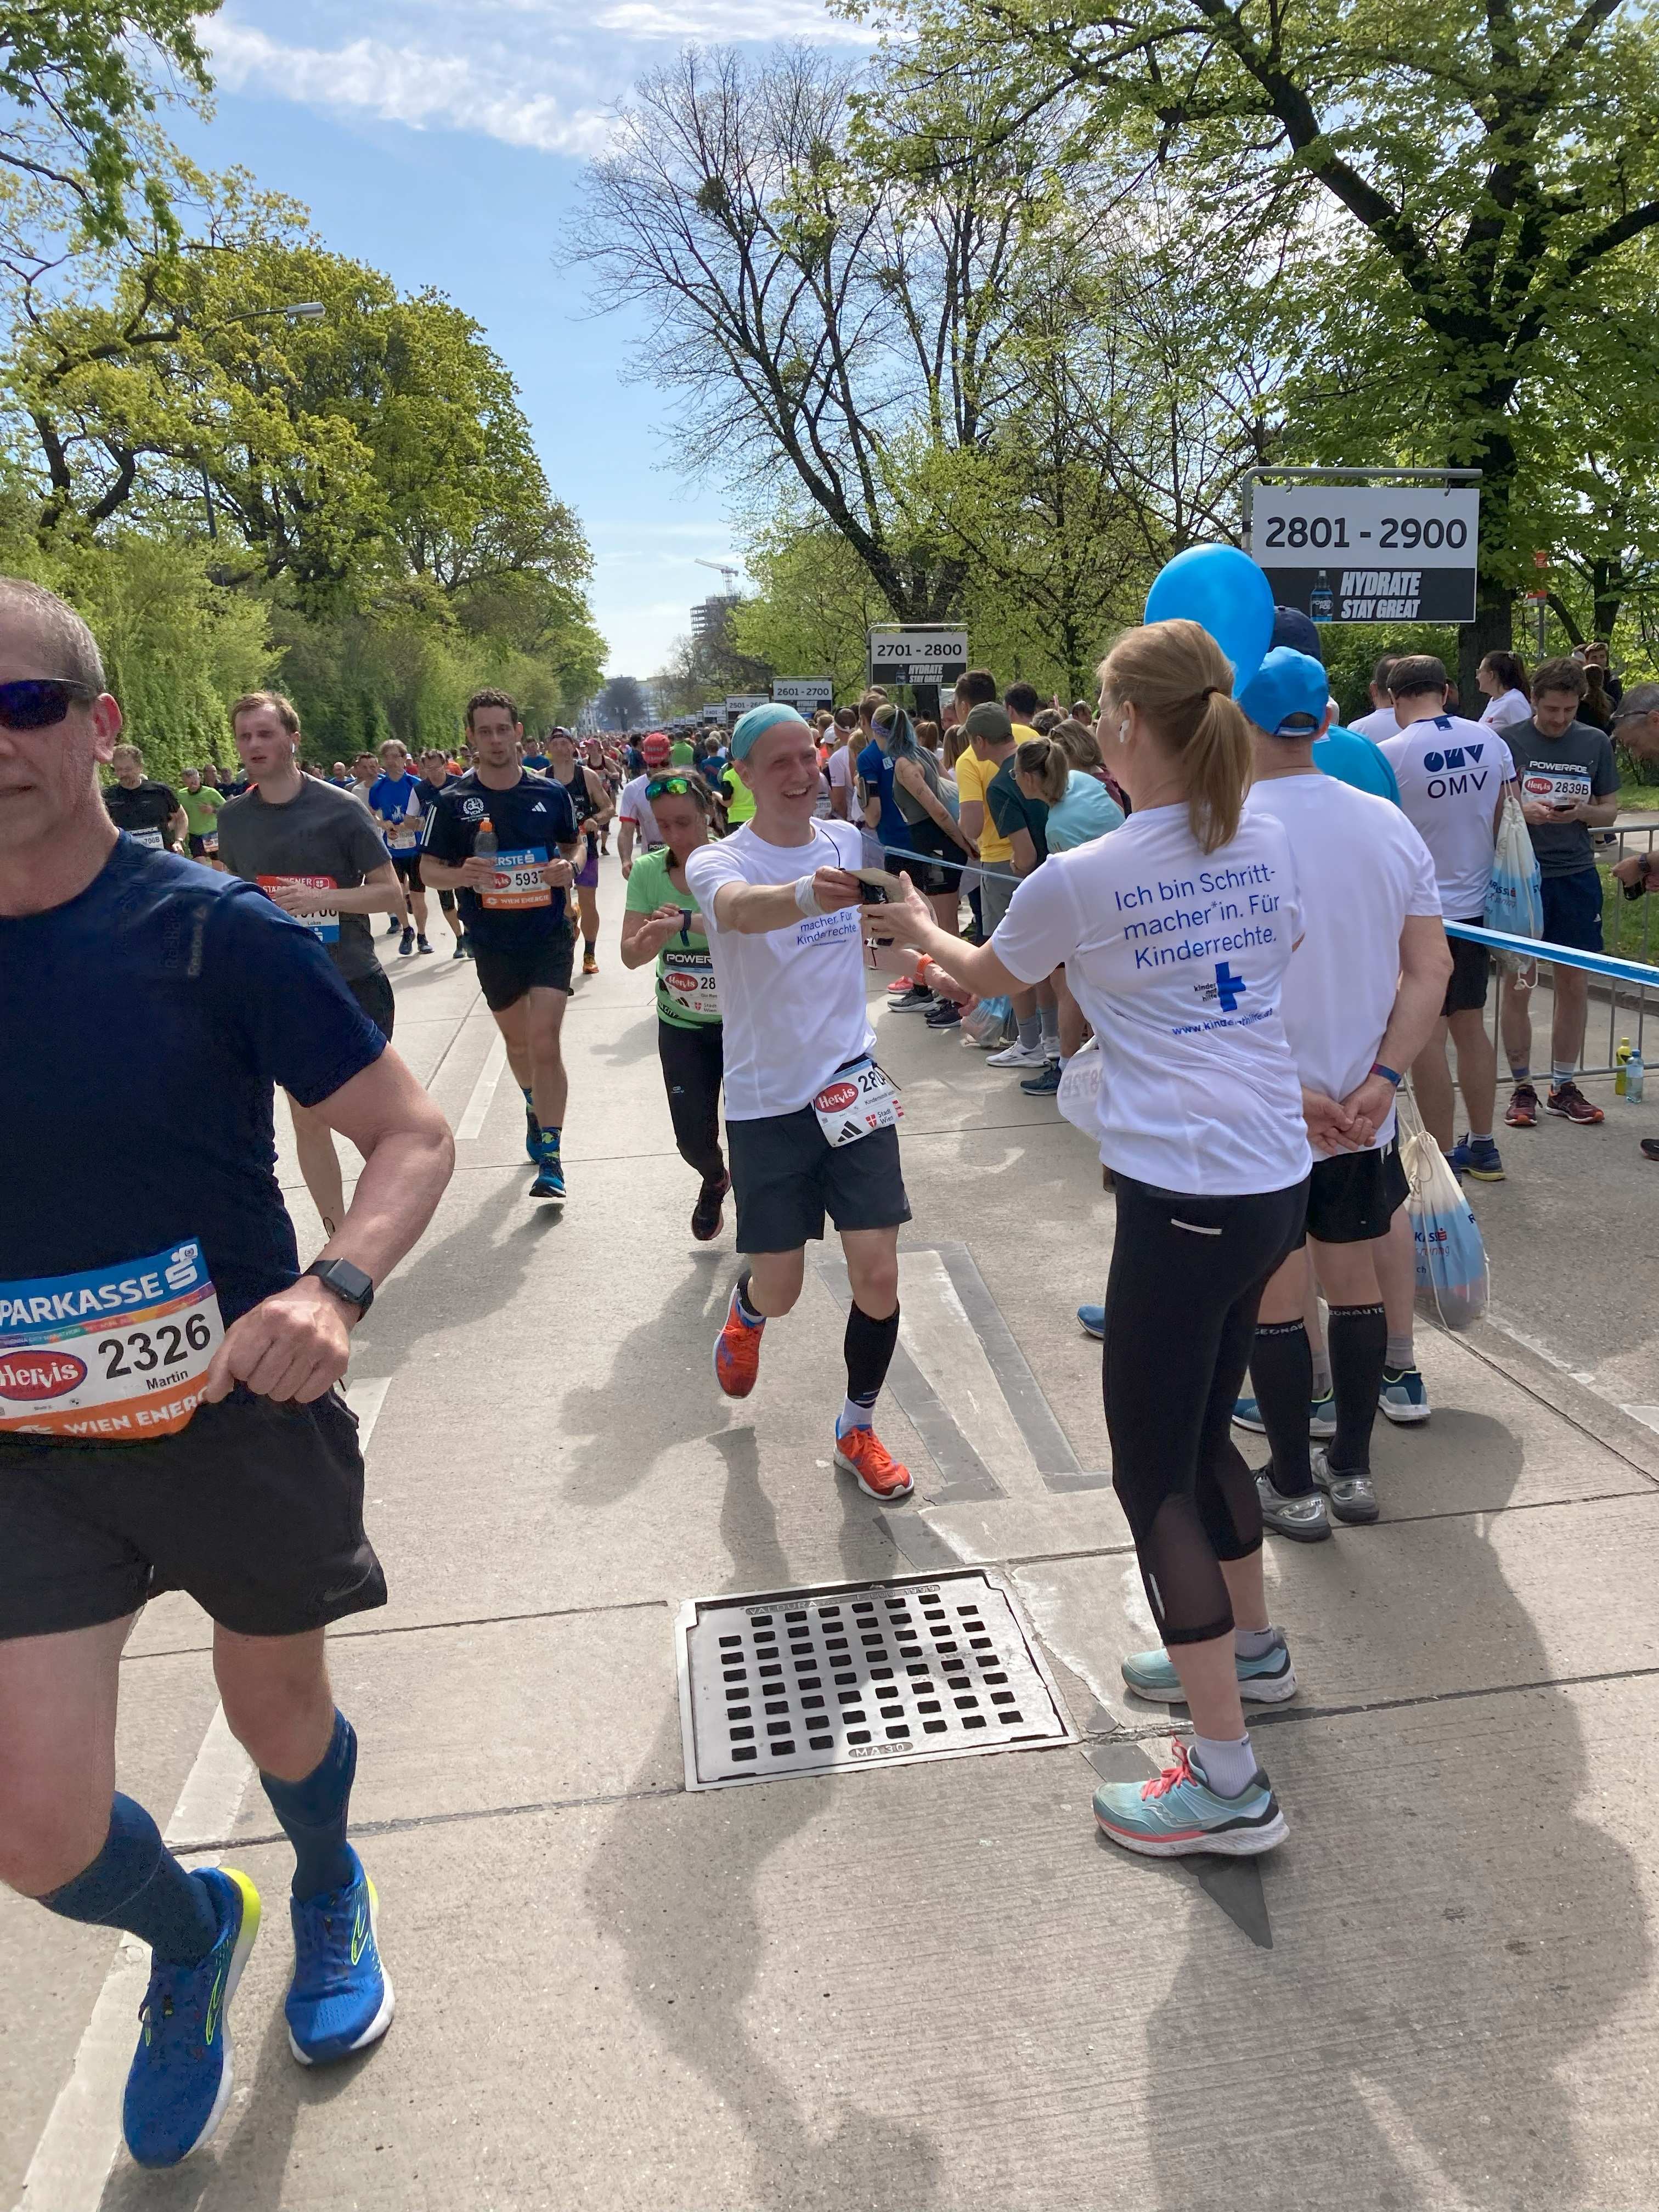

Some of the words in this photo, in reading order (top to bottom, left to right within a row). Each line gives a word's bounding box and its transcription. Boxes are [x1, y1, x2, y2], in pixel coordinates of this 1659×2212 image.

[1265, 517, 1350, 548] 2801
[1379, 518, 1468, 549] 2900
[1340, 571, 1422, 596] HYDRATE
[1341, 599, 1376, 619] STAY
[1376, 599, 1421, 619] GREAT
[877, 645, 912, 657] 2701
[924, 644, 962, 656] 2800
[908, 664, 944, 675] HYDRATE
[909, 675, 924, 684] STAY
[924, 675, 943, 684] GREAT
[777, 688, 799, 696] 2601
[806, 688, 830, 696] 2700
[1424, 743, 1484, 772] OMV
[1529, 760, 1589, 774] POWERADE
[1427, 770, 1488, 799] OMV
[1527, 780, 1551, 791] Hervis
[1554, 781, 1589, 795] 2839B
[1114, 885, 1153, 911] Ich
[1158, 879, 1195, 901] bin
[1199, 864, 1276, 893] Schritt-
[521, 894, 549, 904] ENERGIE
[1248, 894, 1279, 915] Für
[840, 911, 853, 922] Für
[1135, 926, 1277, 969] Kinderrechte.
[669, 975, 695, 988] Hervis
[1193, 983, 1216, 992] kinder
[818, 1088, 855, 1109] Hervis
[877, 1108, 891, 1119] Stadt
[879, 1115, 894, 1125] Wien
[98, 1313, 211, 1380] 2326
[0, 1362, 80, 1389] Hervis
[145, 1369, 189, 1391] Martin
[64, 1415, 132, 1434] WIEN
[748, 1600, 817, 1615] VALDURA
[905, 1585, 935, 1595] 1999
